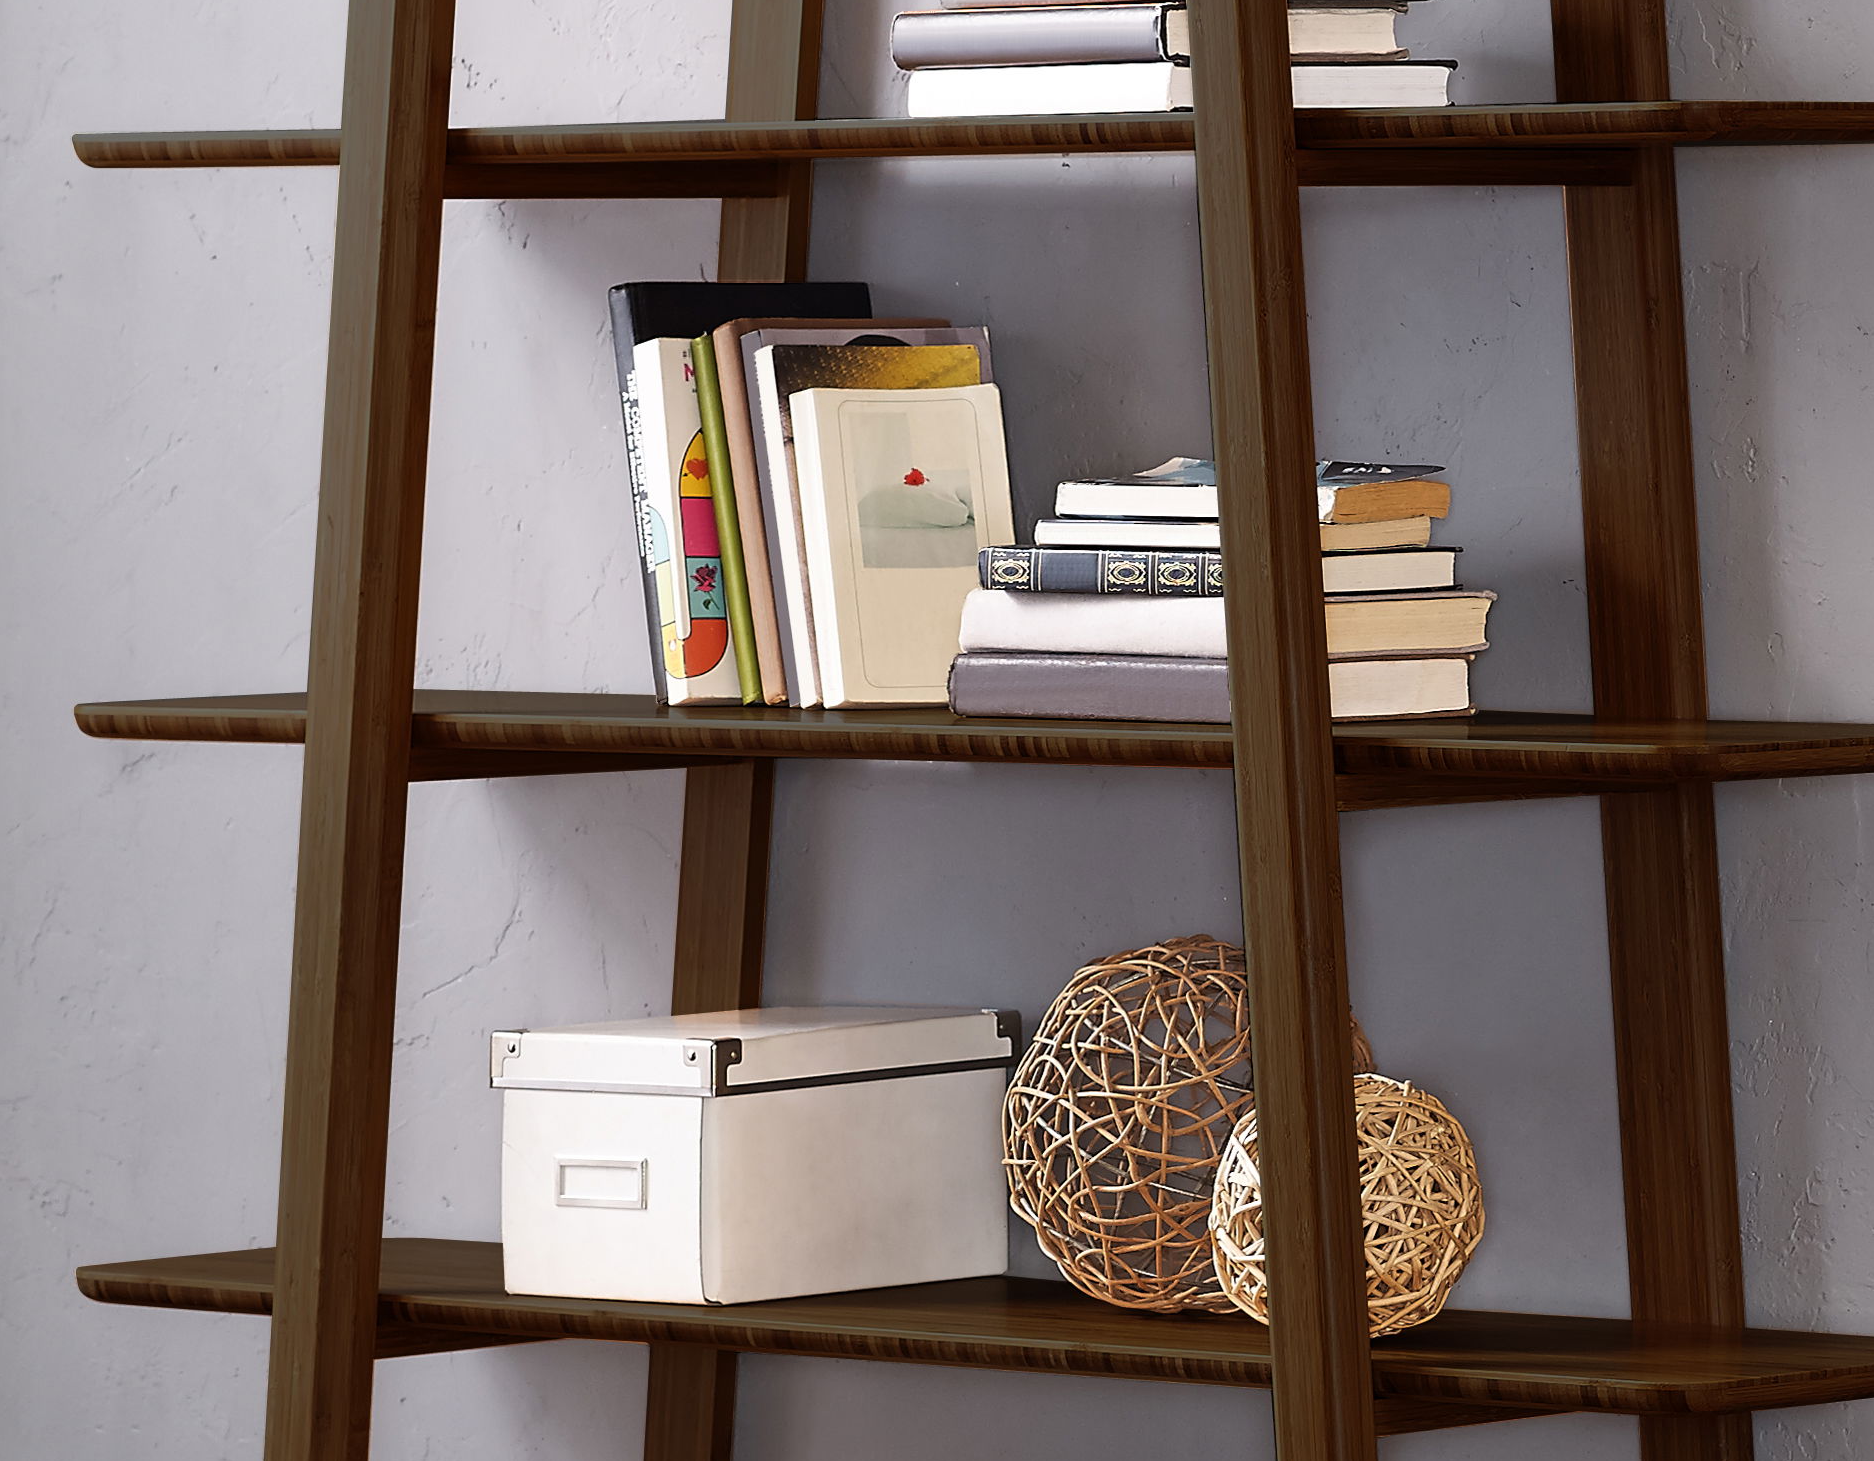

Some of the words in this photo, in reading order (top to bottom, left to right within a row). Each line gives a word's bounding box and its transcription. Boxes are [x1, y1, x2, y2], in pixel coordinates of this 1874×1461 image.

[627, 370, 638, 401] THE
[631, 406, 647, 493] COMPETENT
[641, 499, 655, 573] MANAGER
